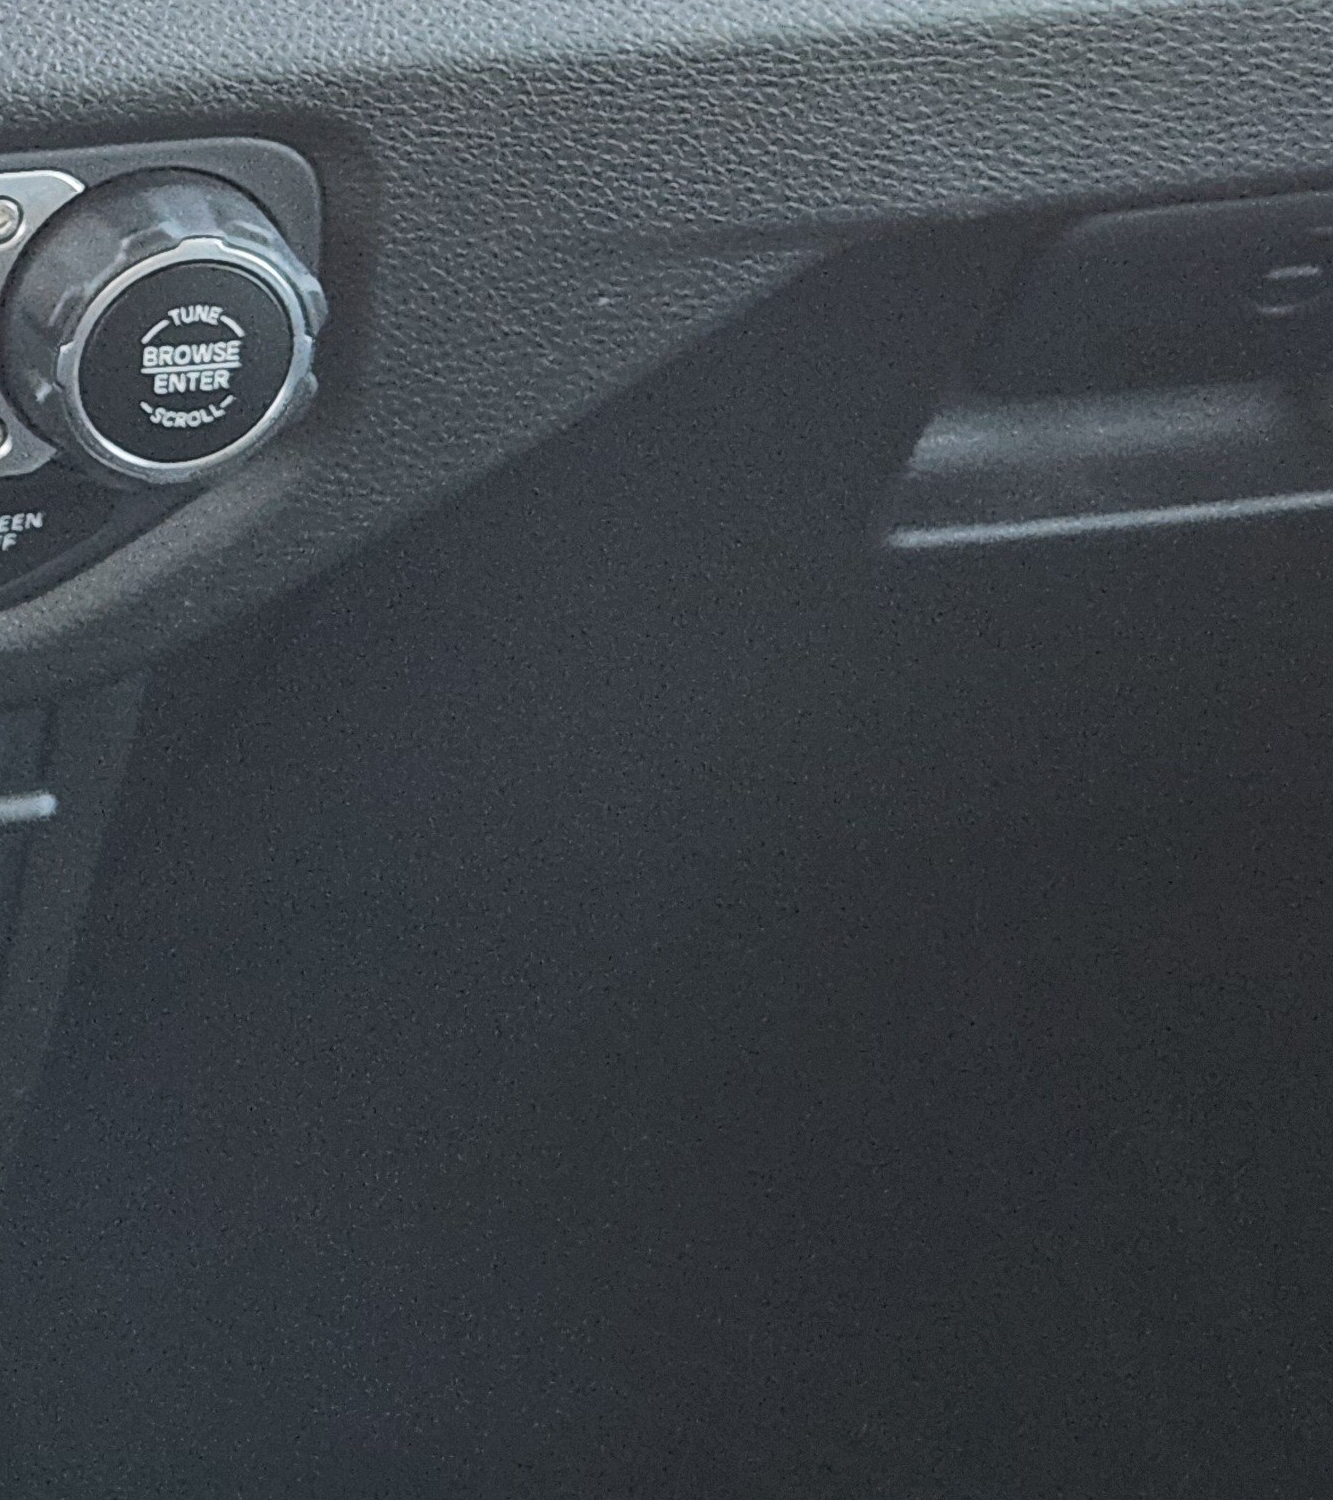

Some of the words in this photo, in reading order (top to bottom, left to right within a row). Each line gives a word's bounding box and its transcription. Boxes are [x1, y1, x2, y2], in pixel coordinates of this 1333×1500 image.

[169, 306, 222, 328] TUNE
[142, 340, 241, 370] BROWSE
[153, 370, 231, 394] ENTER
[151, 403, 227, 429] SCROLL
